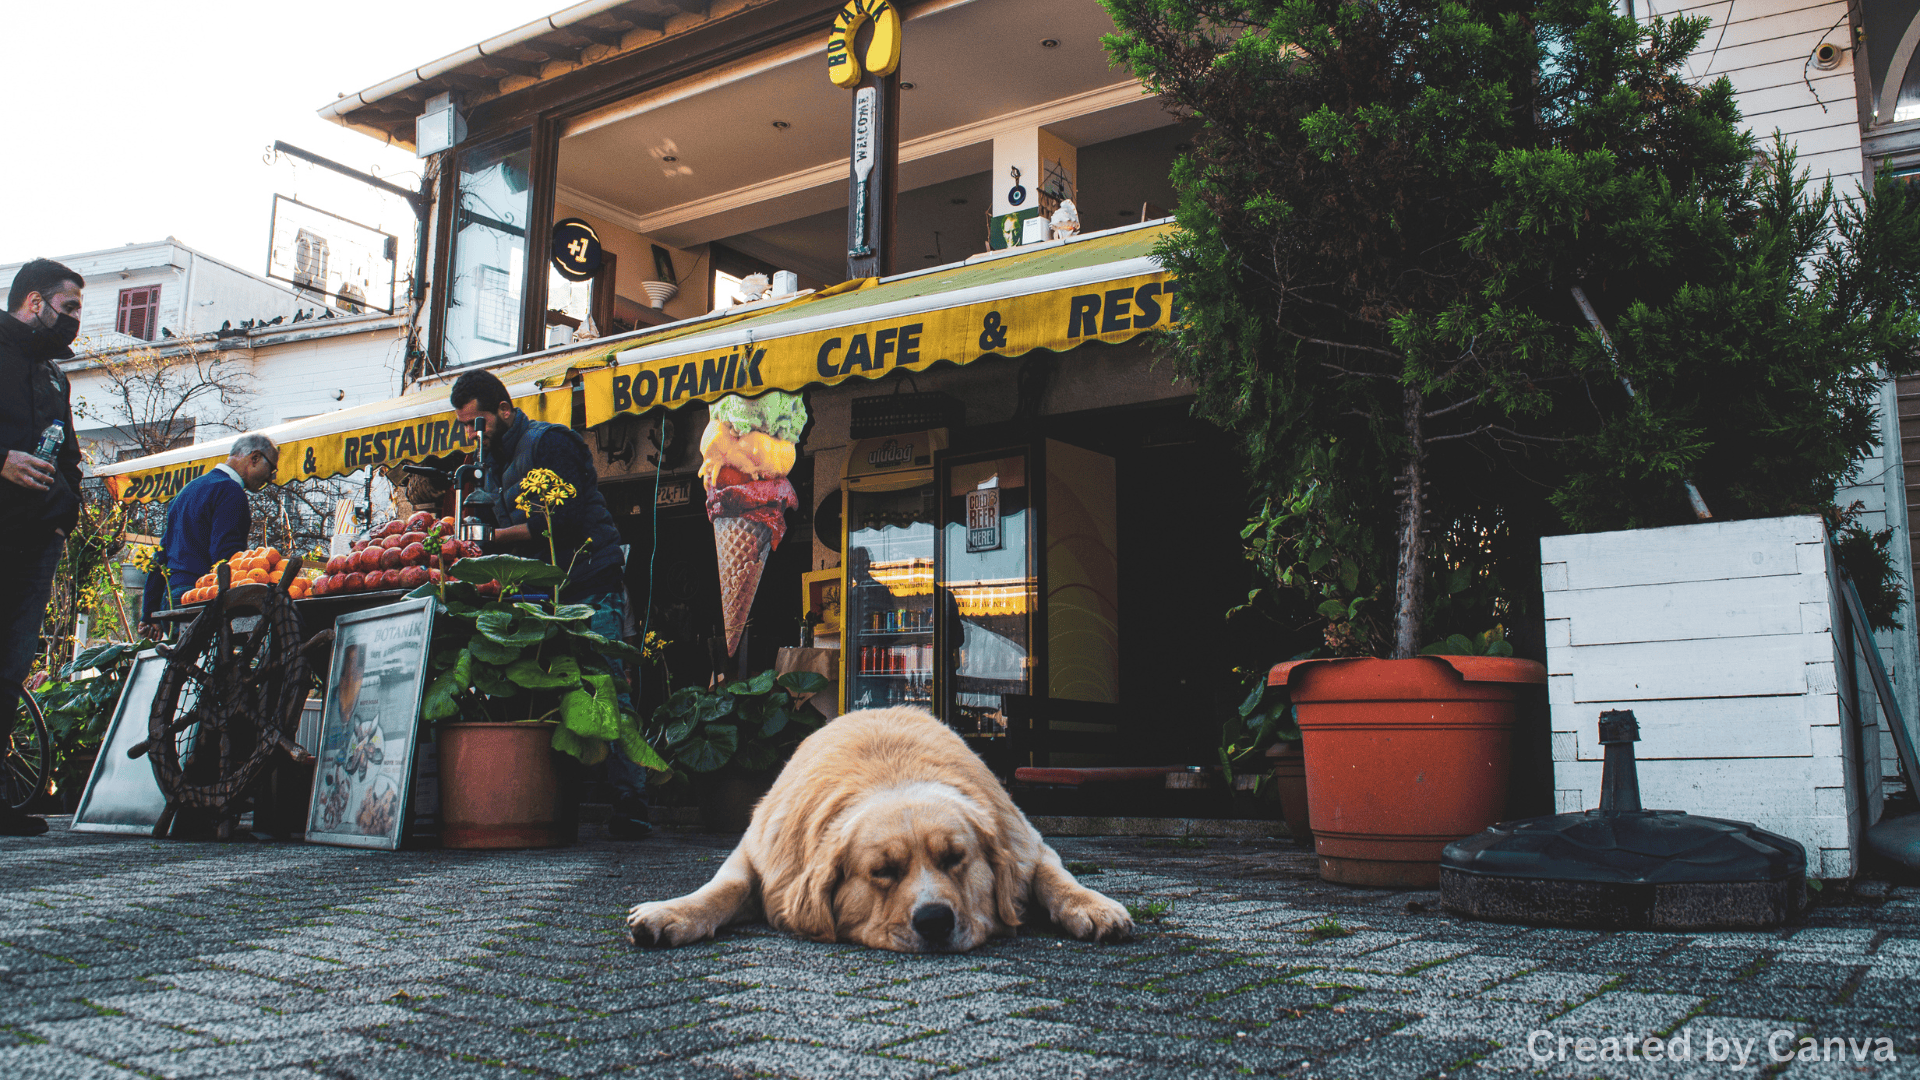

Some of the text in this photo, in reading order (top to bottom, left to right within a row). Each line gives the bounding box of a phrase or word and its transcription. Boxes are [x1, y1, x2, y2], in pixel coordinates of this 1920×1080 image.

[856, 96, 870, 163] WELCOME
[567, 237, 589, 263] +1
[816, 323, 924, 379] CAFE
[978, 310, 1008, 351] &
[303, 446, 317, 474] &
[969, 493, 988, 509] COLD
[969, 507, 996, 529] BEER
[972, 529, 995, 546] HERE!
